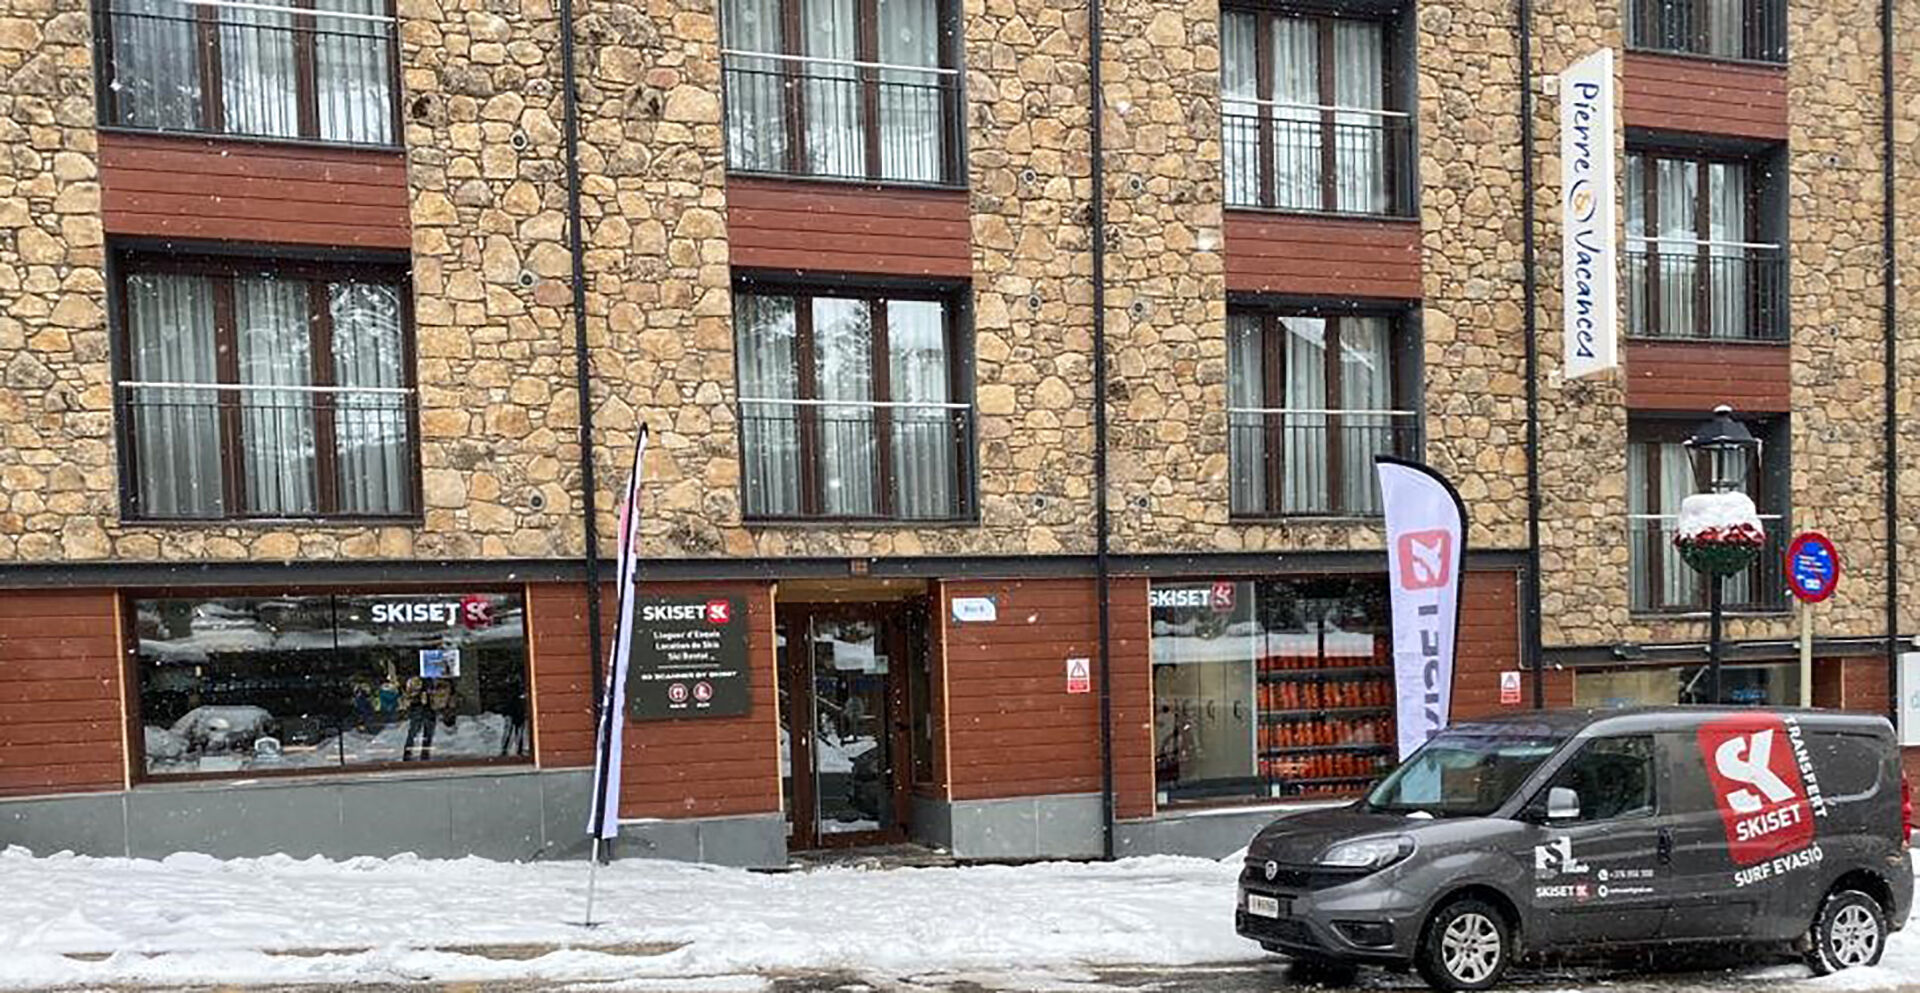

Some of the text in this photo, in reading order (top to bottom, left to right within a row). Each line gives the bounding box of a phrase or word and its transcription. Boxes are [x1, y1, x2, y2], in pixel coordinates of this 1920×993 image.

[1573, 82, 1600, 173] Pierre
[1574, 229, 1601, 359] Vacances
[1149, 589, 1210, 606] SKISET
[371, 603, 460, 626] SKISET
[643, 605, 706, 621] SKISET
[1784, 715, 1828, 818] TRANSFERT
[1736, 804, 1801, 842] SKISET
[1734, 862, 1771, 888] SURF
[1535, 885, 1574, 897] SKISET
